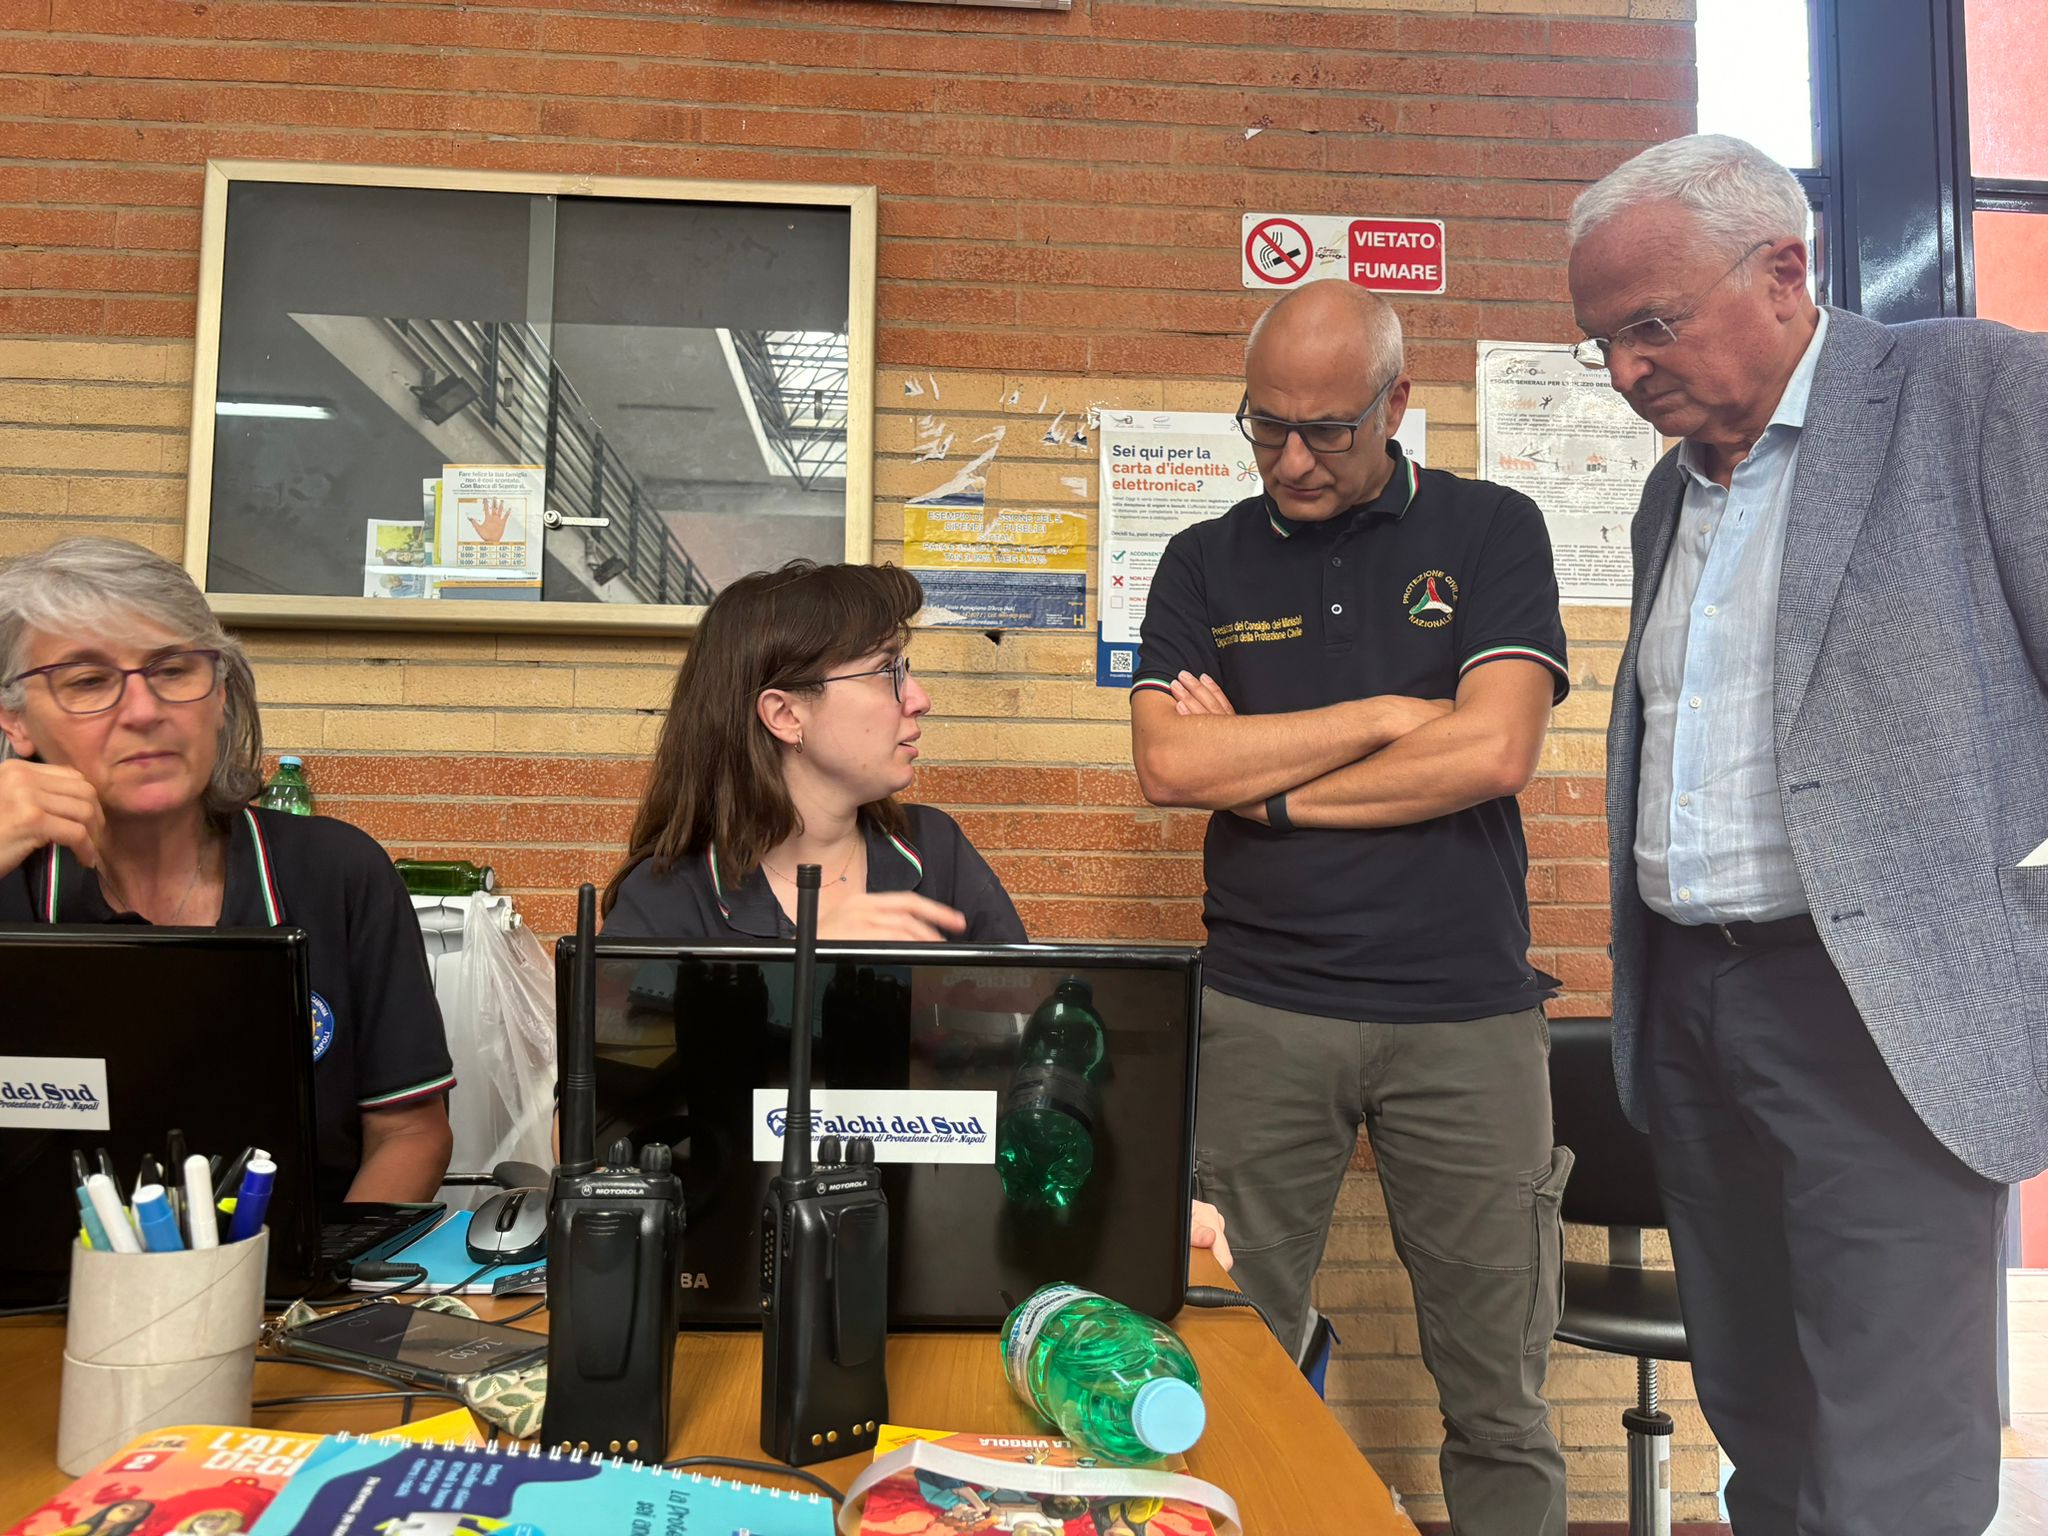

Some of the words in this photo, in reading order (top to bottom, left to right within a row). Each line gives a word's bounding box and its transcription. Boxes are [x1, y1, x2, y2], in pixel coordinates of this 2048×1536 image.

[1354, 231, 1435, 249] VIETATO
[1354, 263, 1438, 280] FUMARE
[1112, 445, 1135, 457] Sei
[1140, 446, 1163, 460] qui
[1168, 449, 1193, 461] per
[1197, 447, 1211, 459] la
[1112, 463, 1152, 474] carta
[1156, 462, 1230, 476] d'identità
[1112, 478, 1203, 492] elettronica?
[944, 553, 962, 561] TAN
[1403, 569, 1444, 604] PROTEZIONE
[1445, 576, 1458, 601] CIVILE
[1408, 614, 1453, 628] NAZIONALE
[1254, 631, 1286, 641] Protezione
[2, 1082, 43, 1100] del
[41, 1083, 99, 1101] Sud
[42, 1101, 66, 1110] Civile
[70, 1102, 99, 1111] Napoli
[811, 1115, 889, 1133] Falchi
[892, 1116, 932, 1134] del
[931, 1116, 986, 1135] Sud
[885, 1134, 932, 1142] Protezione
[930, 1135, 954, 1143] Civile
[959, 1135, 986, 1145] Napoli
[829, 1180, 867, 1191] MOTOROLA
[680, 1272, 709, 1289] BA
[208, 1432, 322, 1458] L'ATT
[979, 1437, 1048, 1448] VIRGOLA
[1053, 1440, 1072, 1448] LA
[123, 1454, 157, 1470] 2
[201, 1451, 305, 1477] DECI
[669, 1490, 691, 1503] La
[635, 1500, 656, 1518] sei
[665, 1504, 690, 1536] Prote
